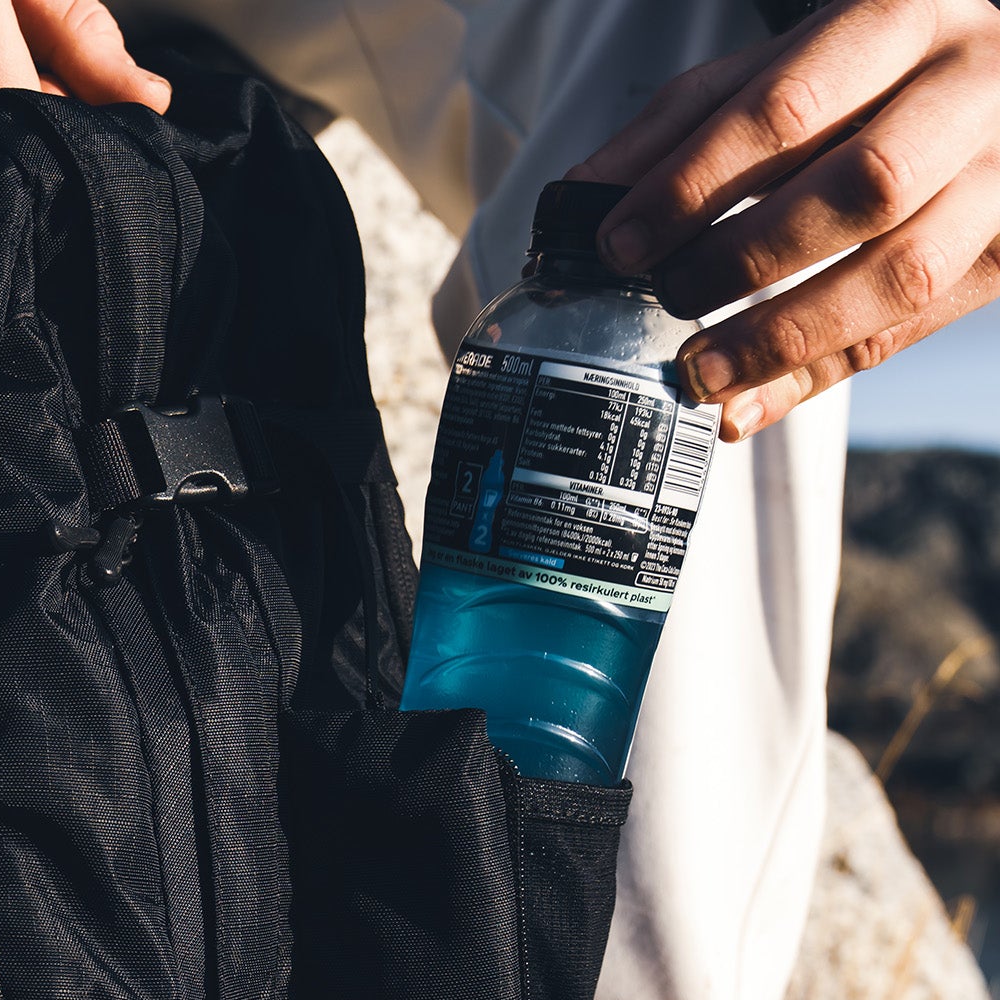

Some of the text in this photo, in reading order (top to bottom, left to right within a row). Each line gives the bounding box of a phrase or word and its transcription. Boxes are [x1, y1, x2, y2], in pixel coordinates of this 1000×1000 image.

[500, 354, 534, 376] 500ml
[608, 389, 626, 401] 100ml
[637, 395, 655, 407] 250ml
[551, 422, 575, 434] mettede
[462, 471, 473, 493] 2
[452, 500, 472, 514] PANT
[474, 525, 489, 545] 2
[573, 523, 594, 534] voksen
[541, 557, 557, 566] kald
[487, 561, 516, 577] laget
[520, 572, 533, 580] av
[535, 570, 567, 588] 100%
[570, 582, 629, 600] resirkulert
